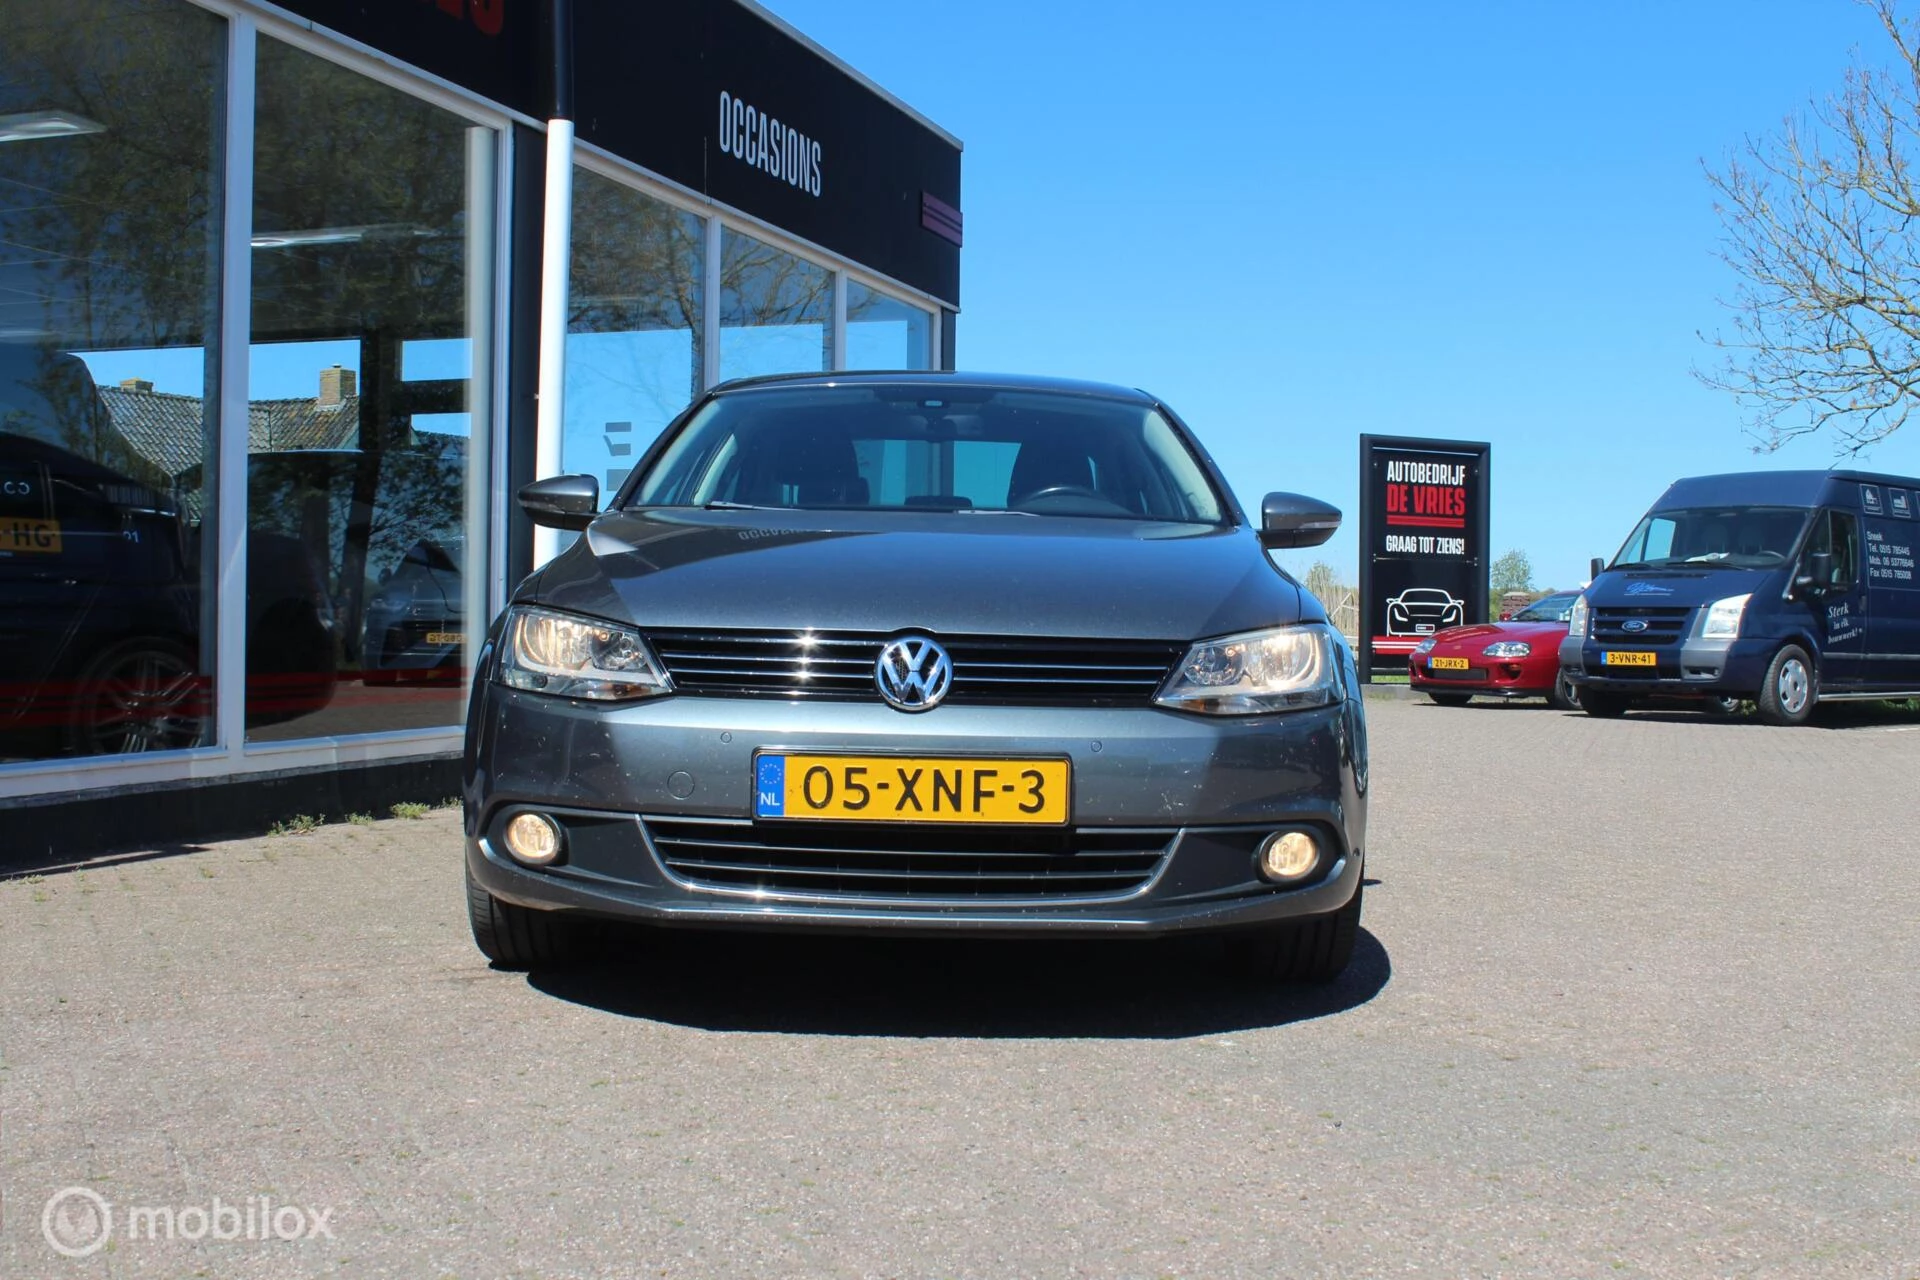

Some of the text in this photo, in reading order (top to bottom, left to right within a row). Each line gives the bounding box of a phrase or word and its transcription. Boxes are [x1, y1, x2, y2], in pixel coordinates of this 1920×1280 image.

[719, 90, 822, 198] OCCASIONS
[1386, 460, 1466, 486] AUTOBEDRIJF
[1386, 483, 1466, 516] DE VRIES
[1385, 534, 1465, 556] GRAAG TOT ZIENS!
[1828, 602, 1849, 618] Sterk
[1434, 658, 1465, 668] 21-JRX-2
[1610, 653, 1651, 664] 3-VNR-41
[760, 791, 781, 806] NL
[802, 765, 1046, 814] 05-XNF-3
